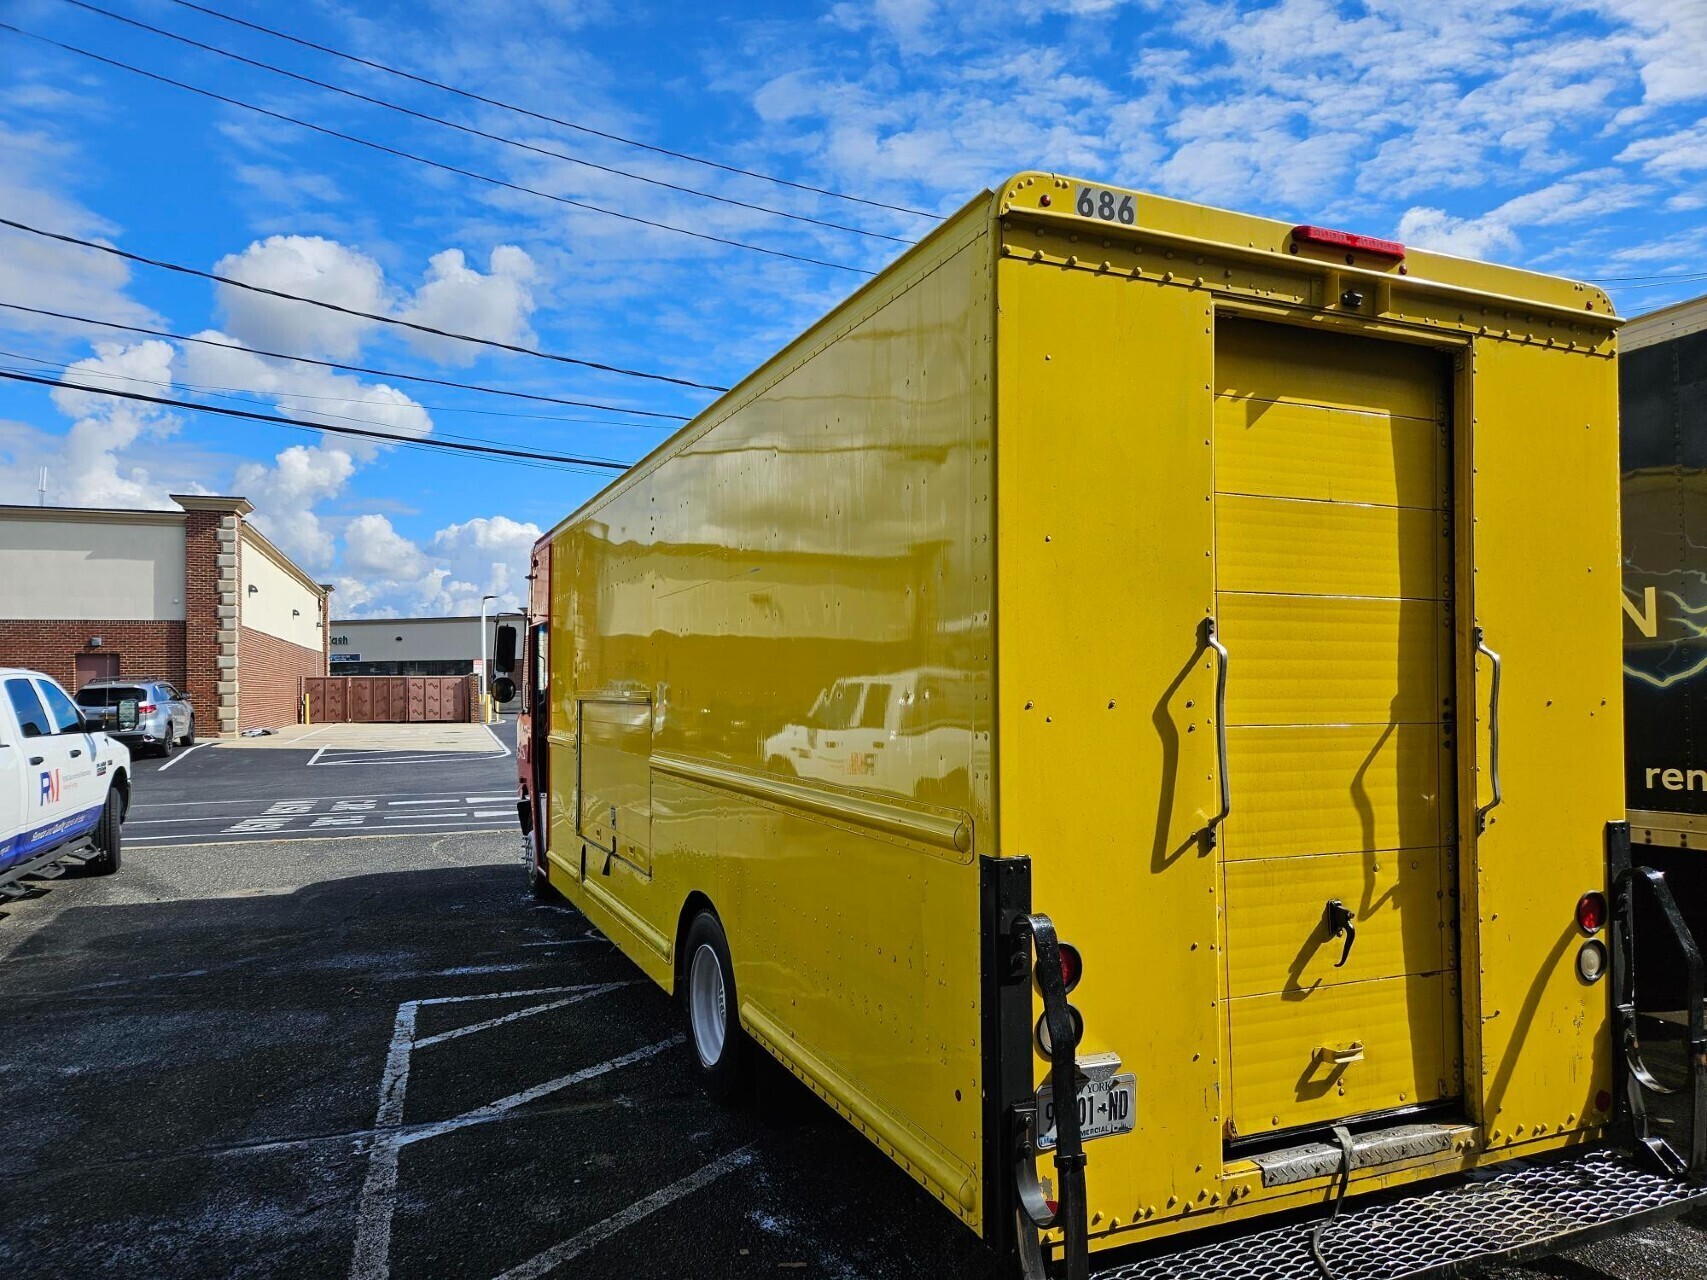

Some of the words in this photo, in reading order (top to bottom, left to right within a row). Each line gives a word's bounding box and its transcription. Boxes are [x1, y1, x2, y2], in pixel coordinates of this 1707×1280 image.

[1077, 187, 1135, 225] 686
[329, 635, 349, 645] ash
[1645, 767, 1707, 792] ren
[1086, 1081, 1112, 1094] YORK
[1108, 1090, 1129, 1122] ND
